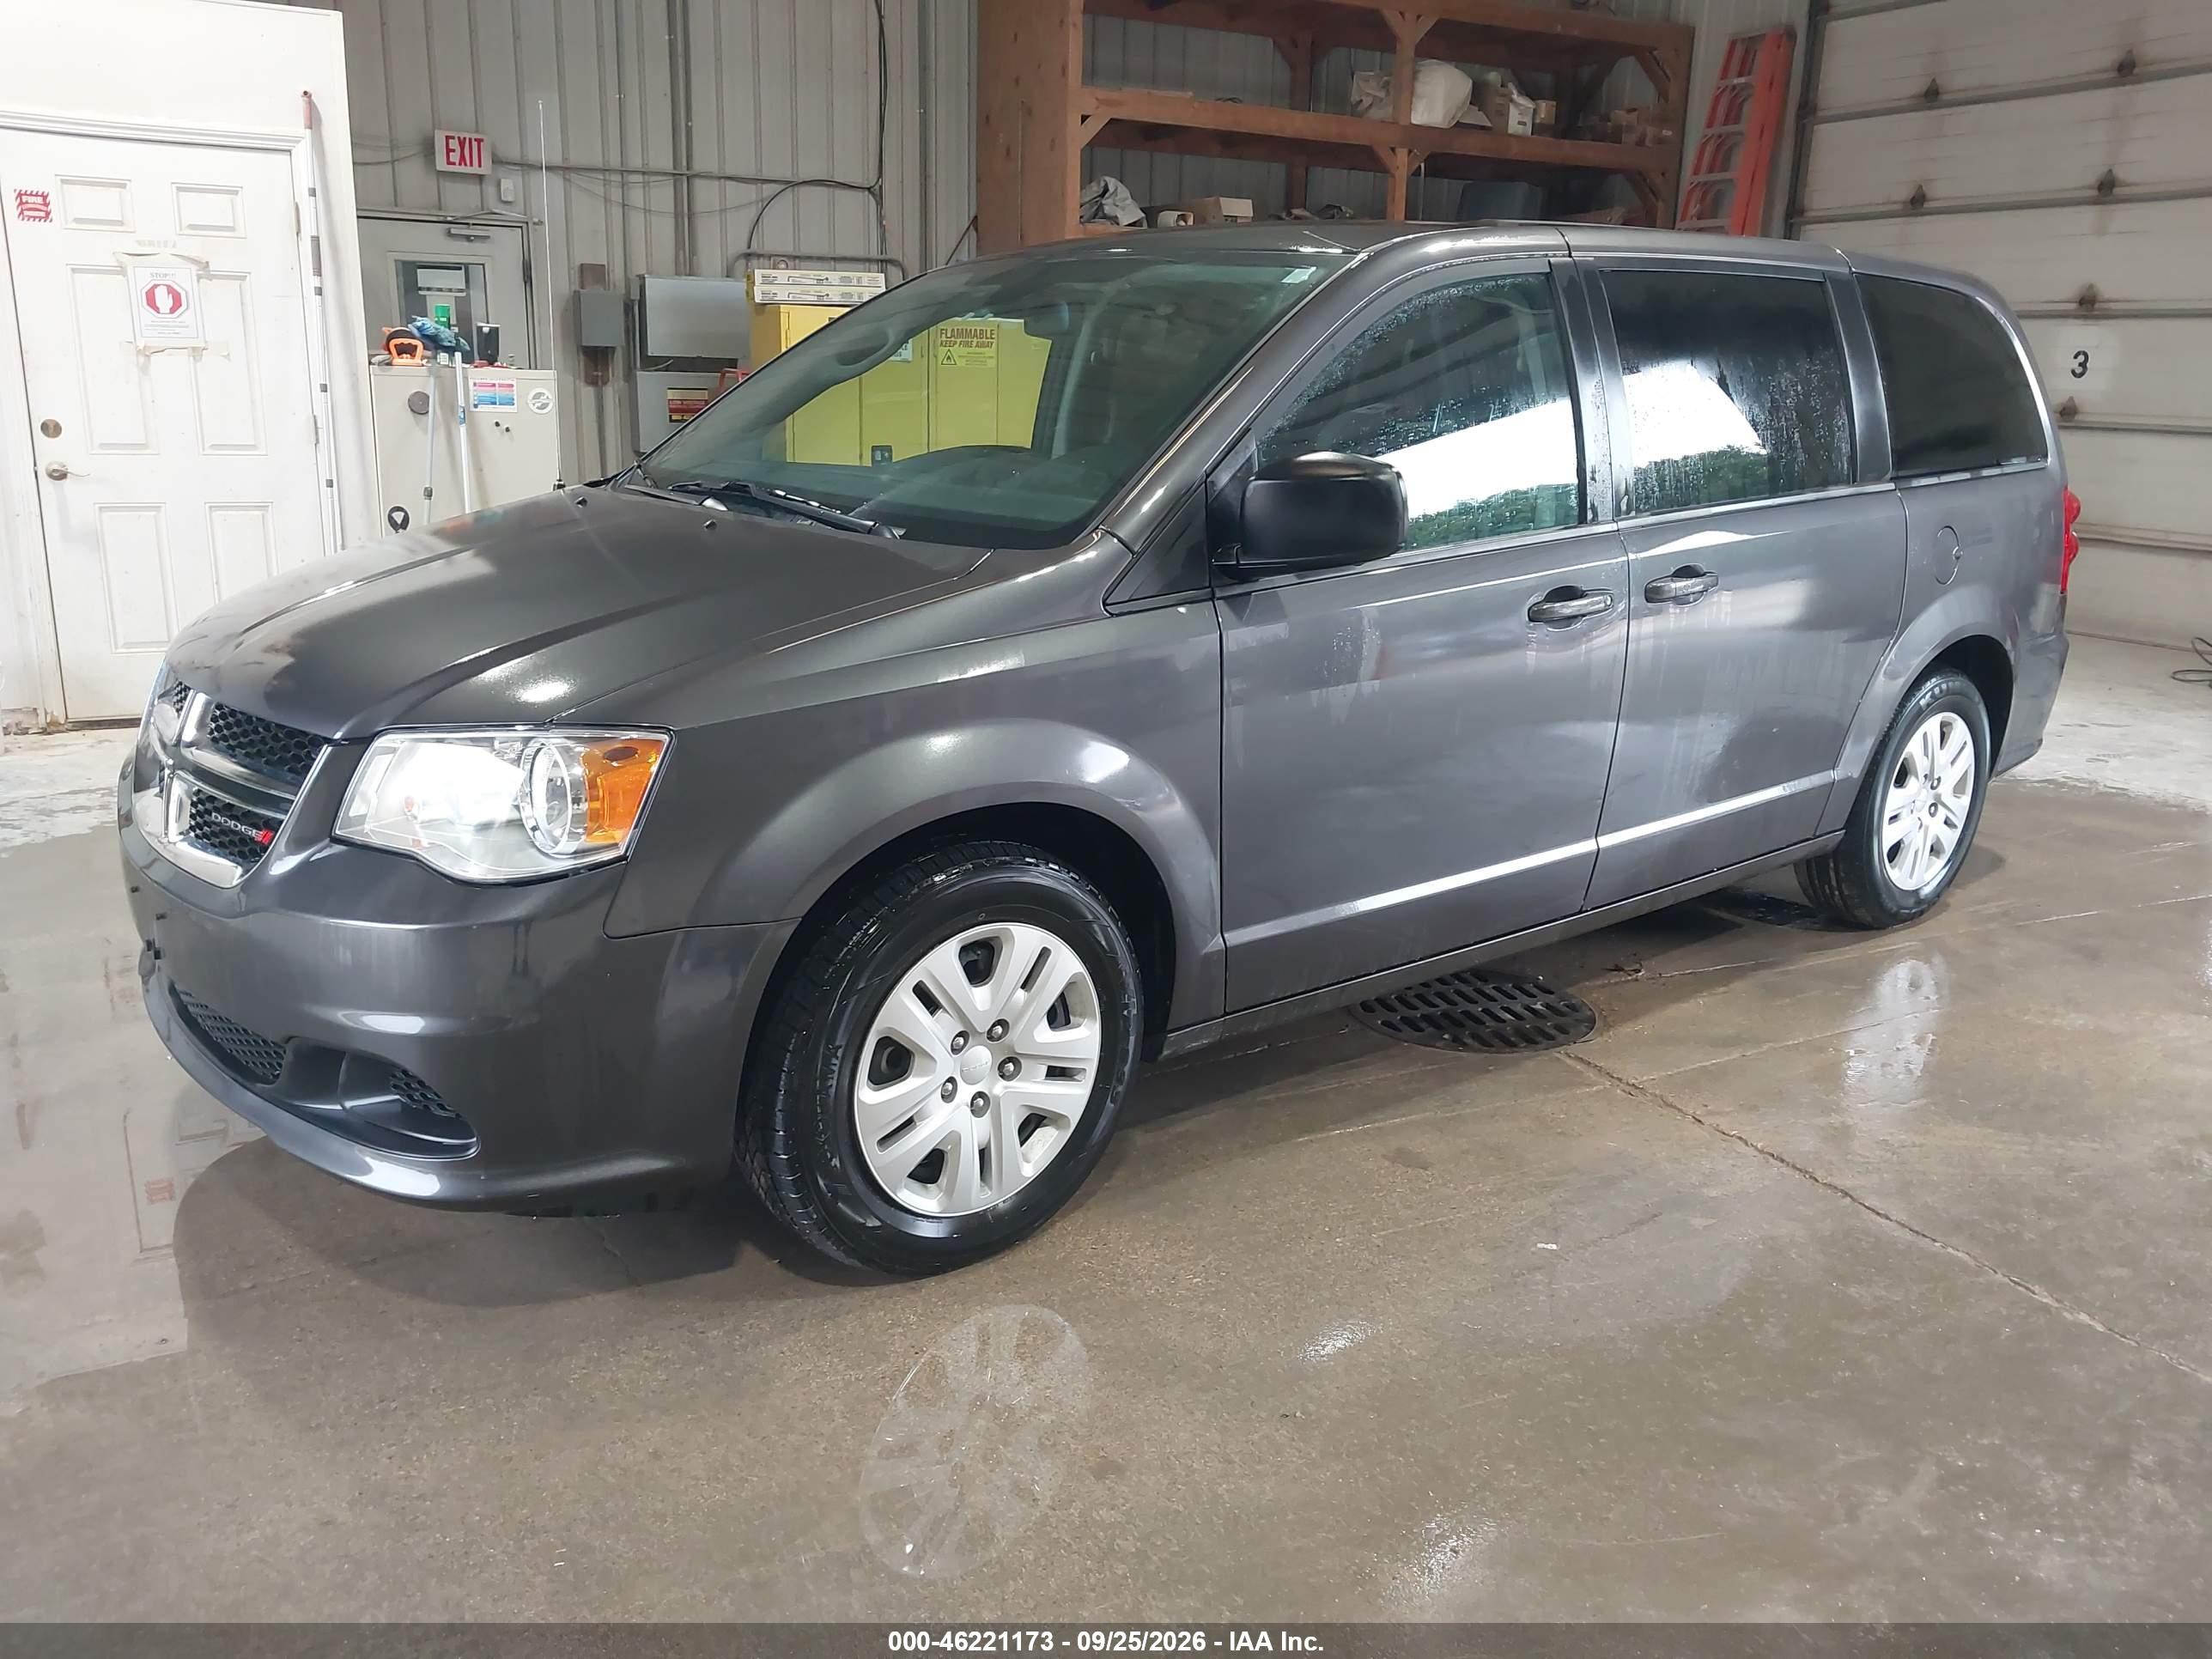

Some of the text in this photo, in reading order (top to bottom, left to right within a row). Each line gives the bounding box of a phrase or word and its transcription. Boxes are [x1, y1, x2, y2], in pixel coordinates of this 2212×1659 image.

[445, 136, 484, 167] EXIT
[21, 196, 43, 204] FIRE
[940, 328, 995, 340] FLAMMABLE
[958, 340, 975, 349] FIRE
[2070, 350, 2089, 379] 3
[212, 811, 264, 840] DODGE
